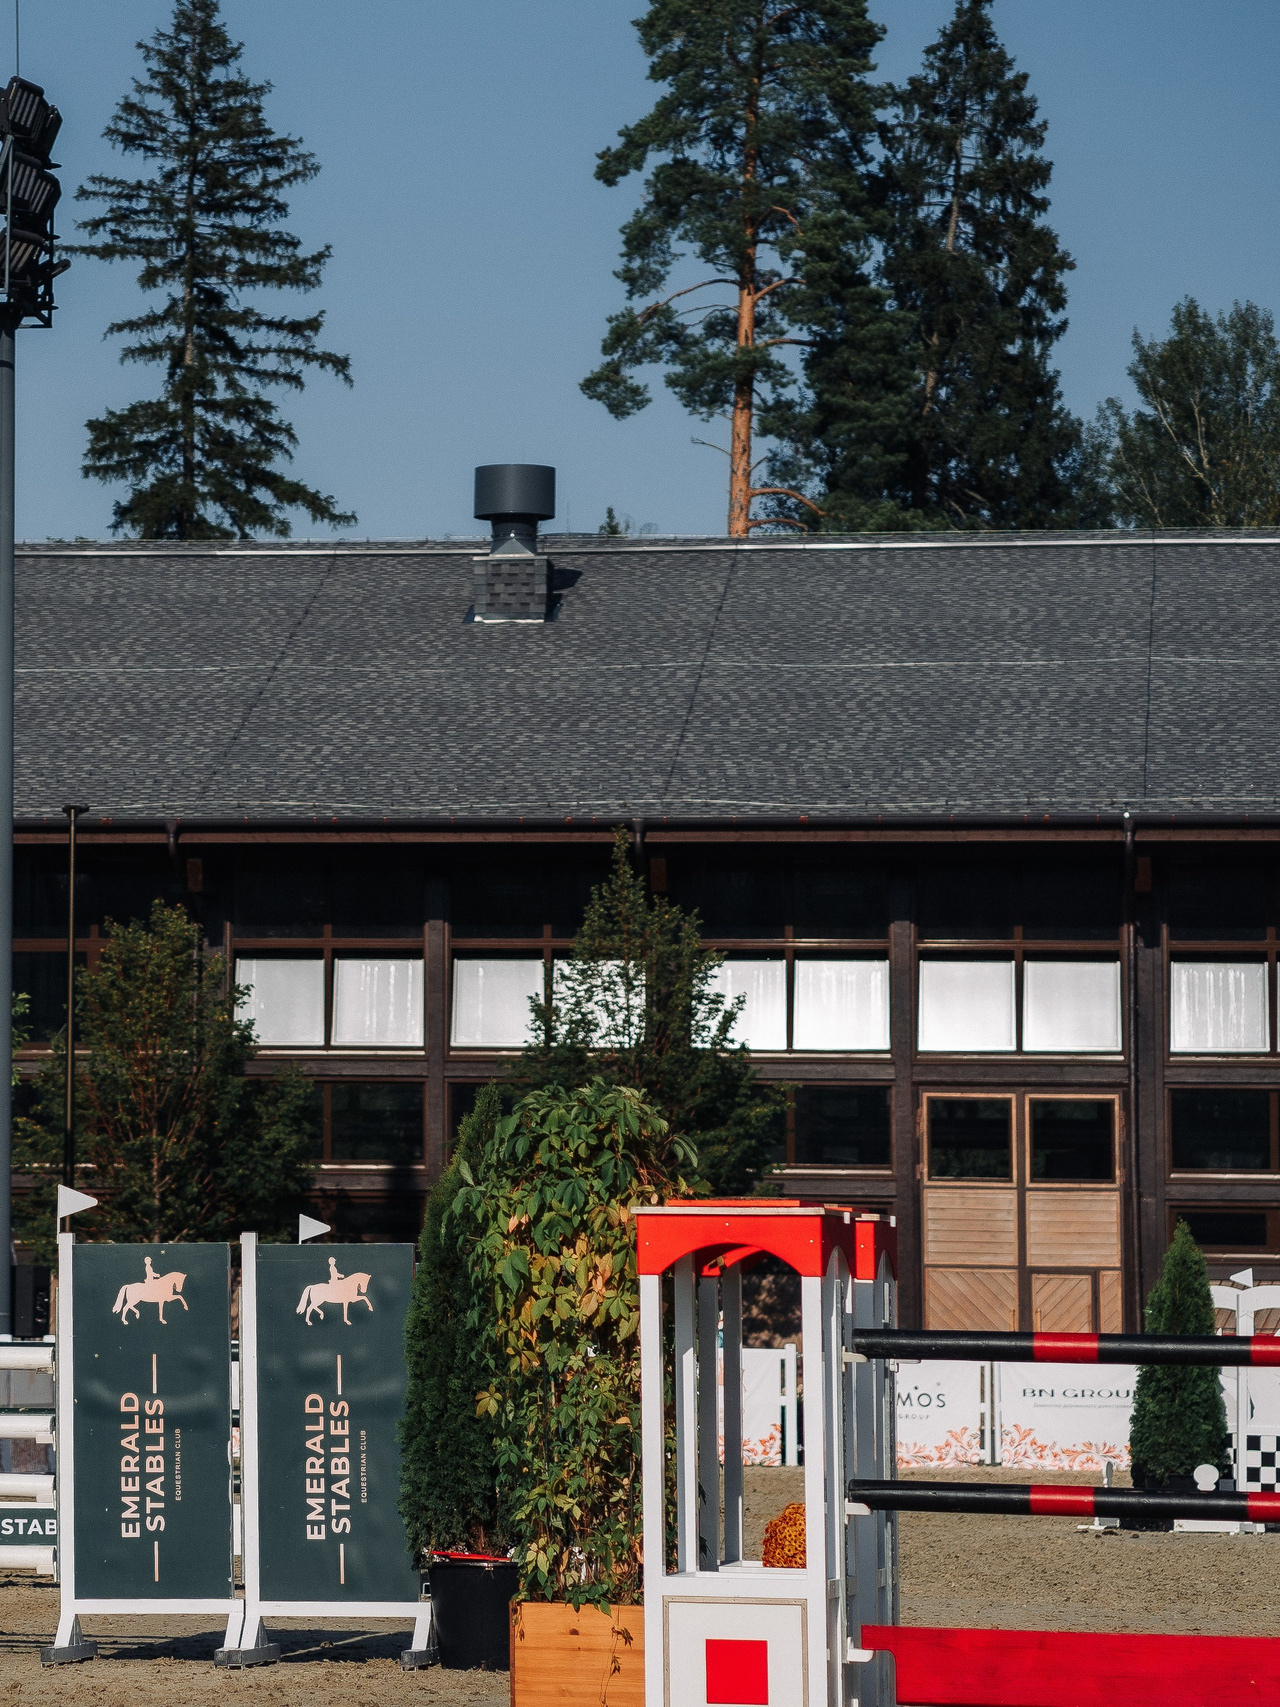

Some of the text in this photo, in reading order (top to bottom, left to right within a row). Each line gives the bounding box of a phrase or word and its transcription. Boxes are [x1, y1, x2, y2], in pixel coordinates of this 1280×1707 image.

[897, 1392, 946, 1408] MOS
[1022, 1388, 1055, 1398] BN
[120, 1392, 141, 1538] EMERALD
[144, 1398, 166, 1532] STABLES
[174, 1428, 183, 1502] EQUESTRIAN CLUB
[304, 1393, 326, 1540] EMERALD
[329, 1400, 351, 1534] STABLES
[360, 1430, 369, 1504] EQUESTRIAN CLUB
[0, 1518, 58, 1535] STAB
